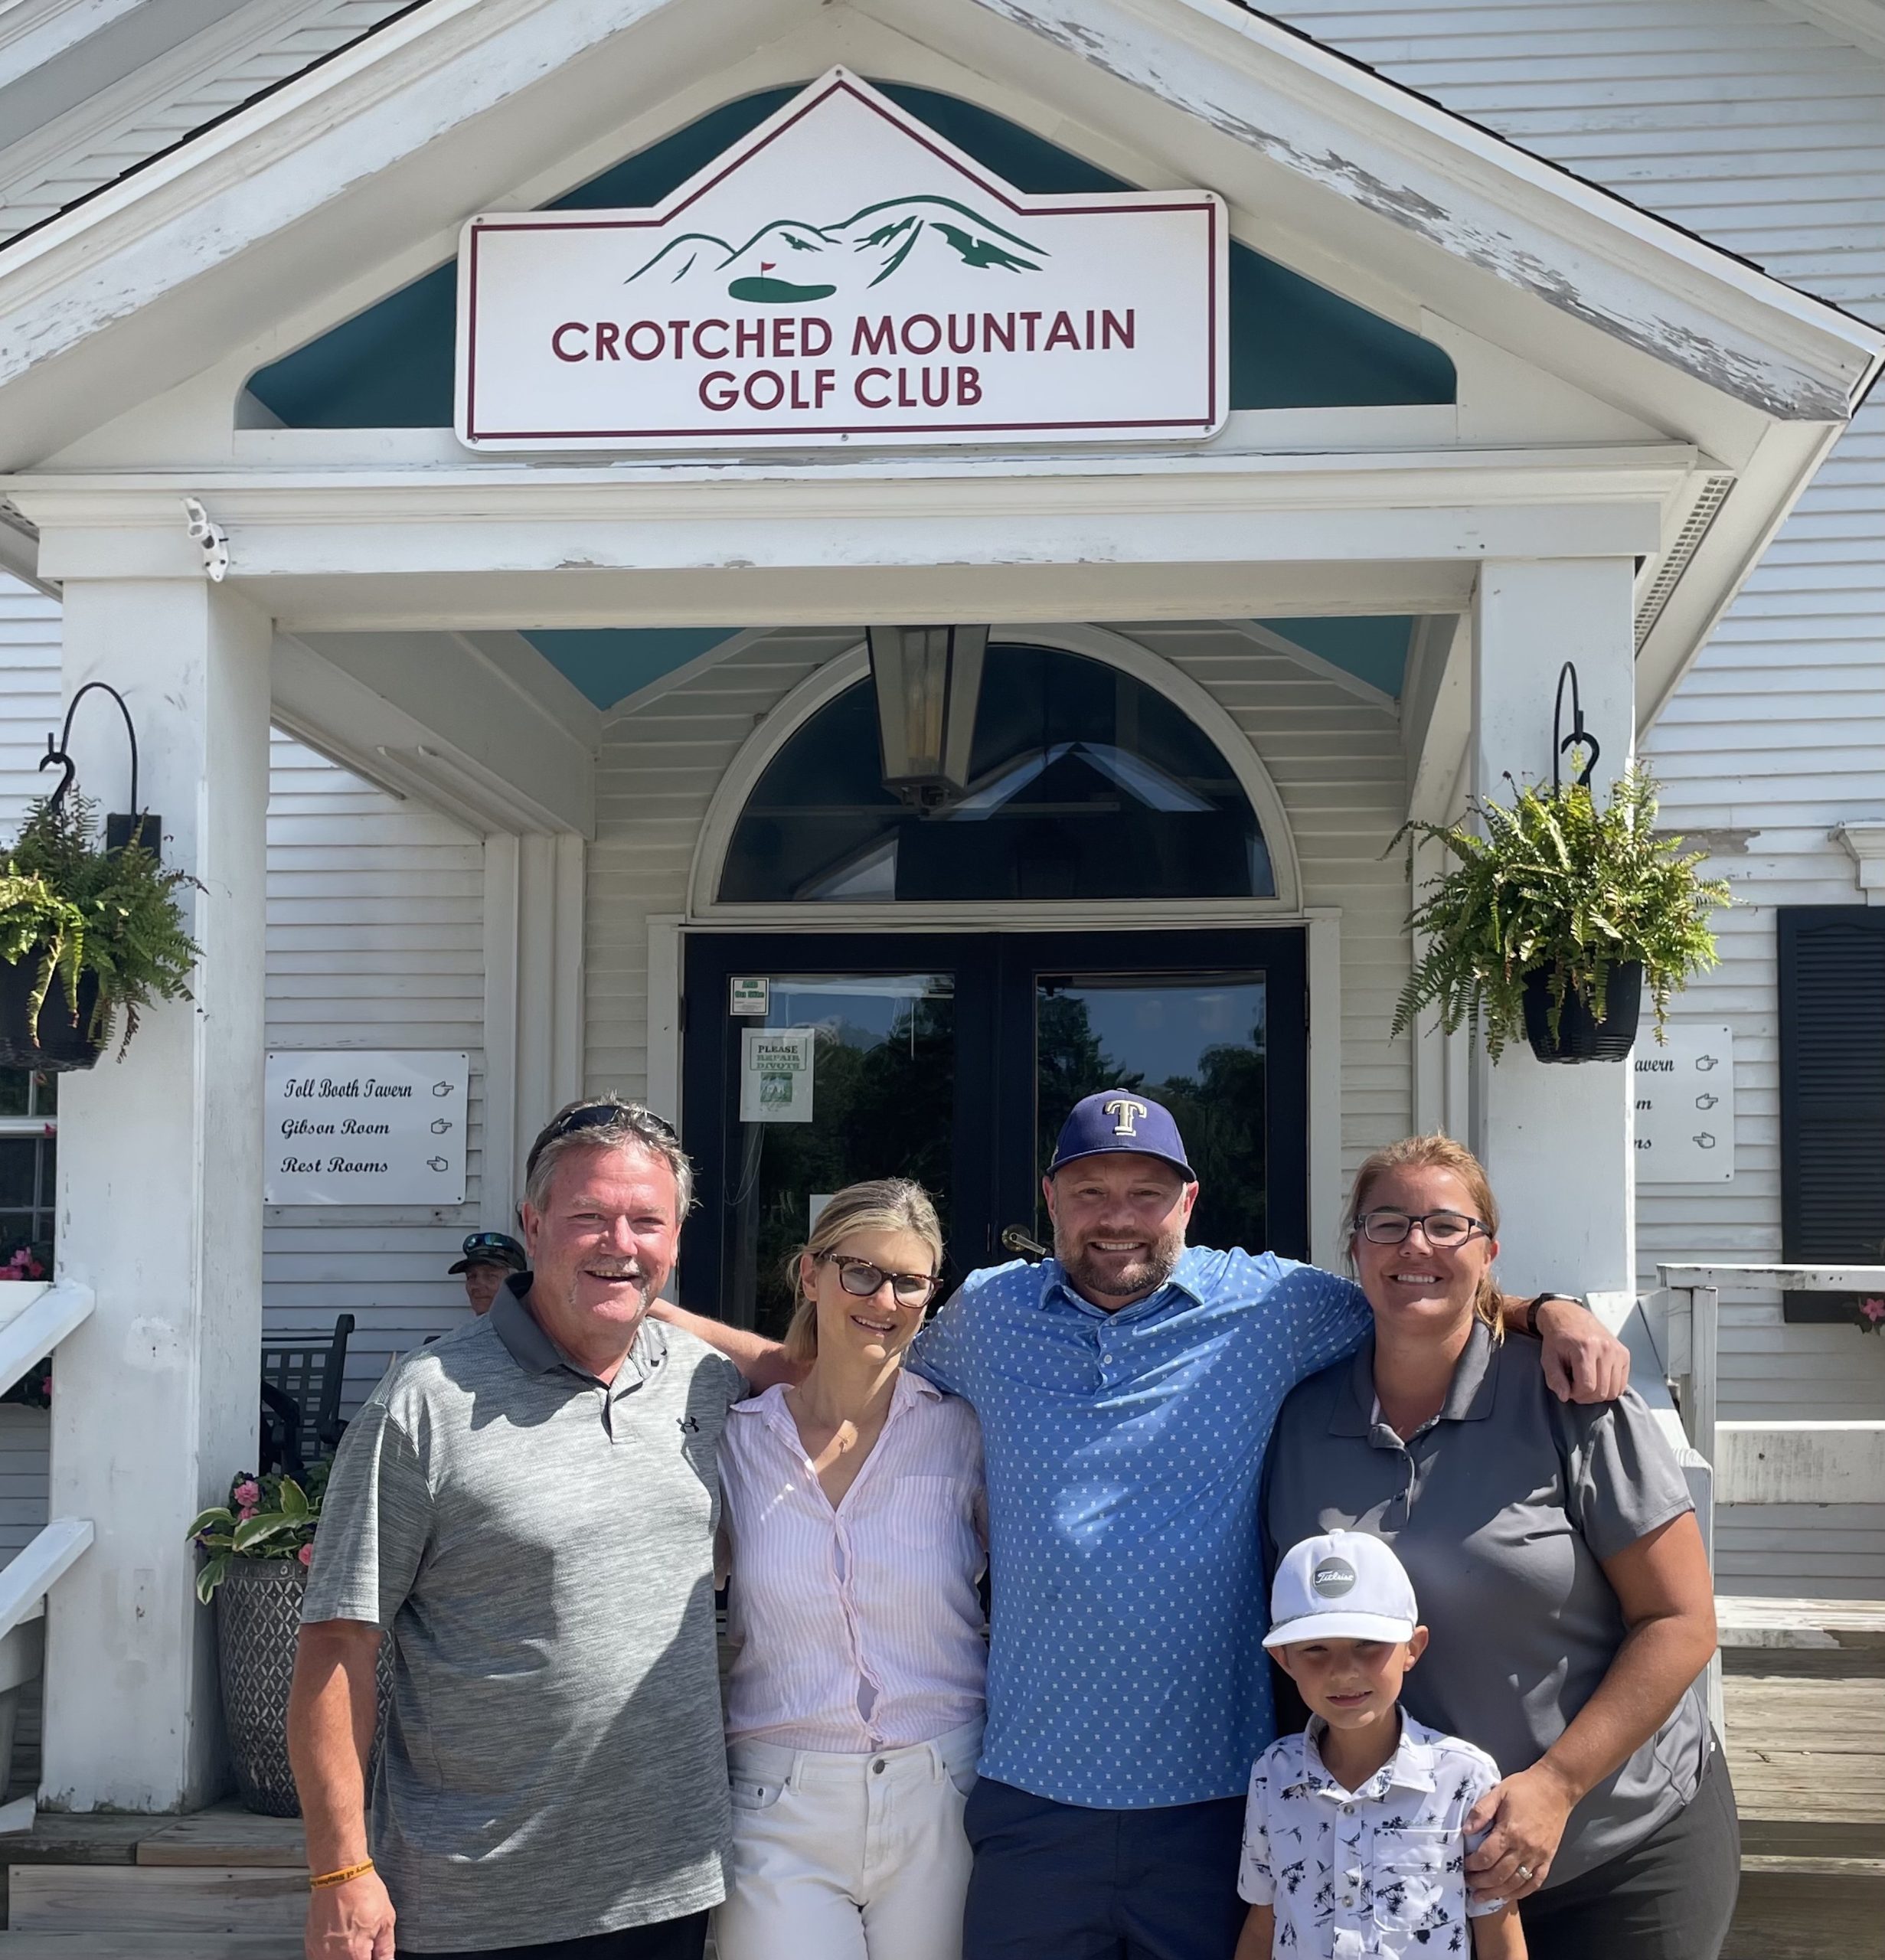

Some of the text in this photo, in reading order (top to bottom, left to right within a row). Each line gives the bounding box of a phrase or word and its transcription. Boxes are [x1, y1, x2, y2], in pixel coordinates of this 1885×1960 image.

[551, 309, 1135, 362] CROTCHED MOUNTAIN
[698, 366, 982, 412] GOLF CLUB
[758, 1044, 798, 1054] PLEASE
[1635, 1059, 1674, 1072] avern
[283, 1078, 413, 1098] Toll Booth Tavern
[1103, 1099, 1147, 1137] T
[281, 1119, 390, 1139] Gibson Room
[280, 1157, 388, 1173] Rest Rooms
